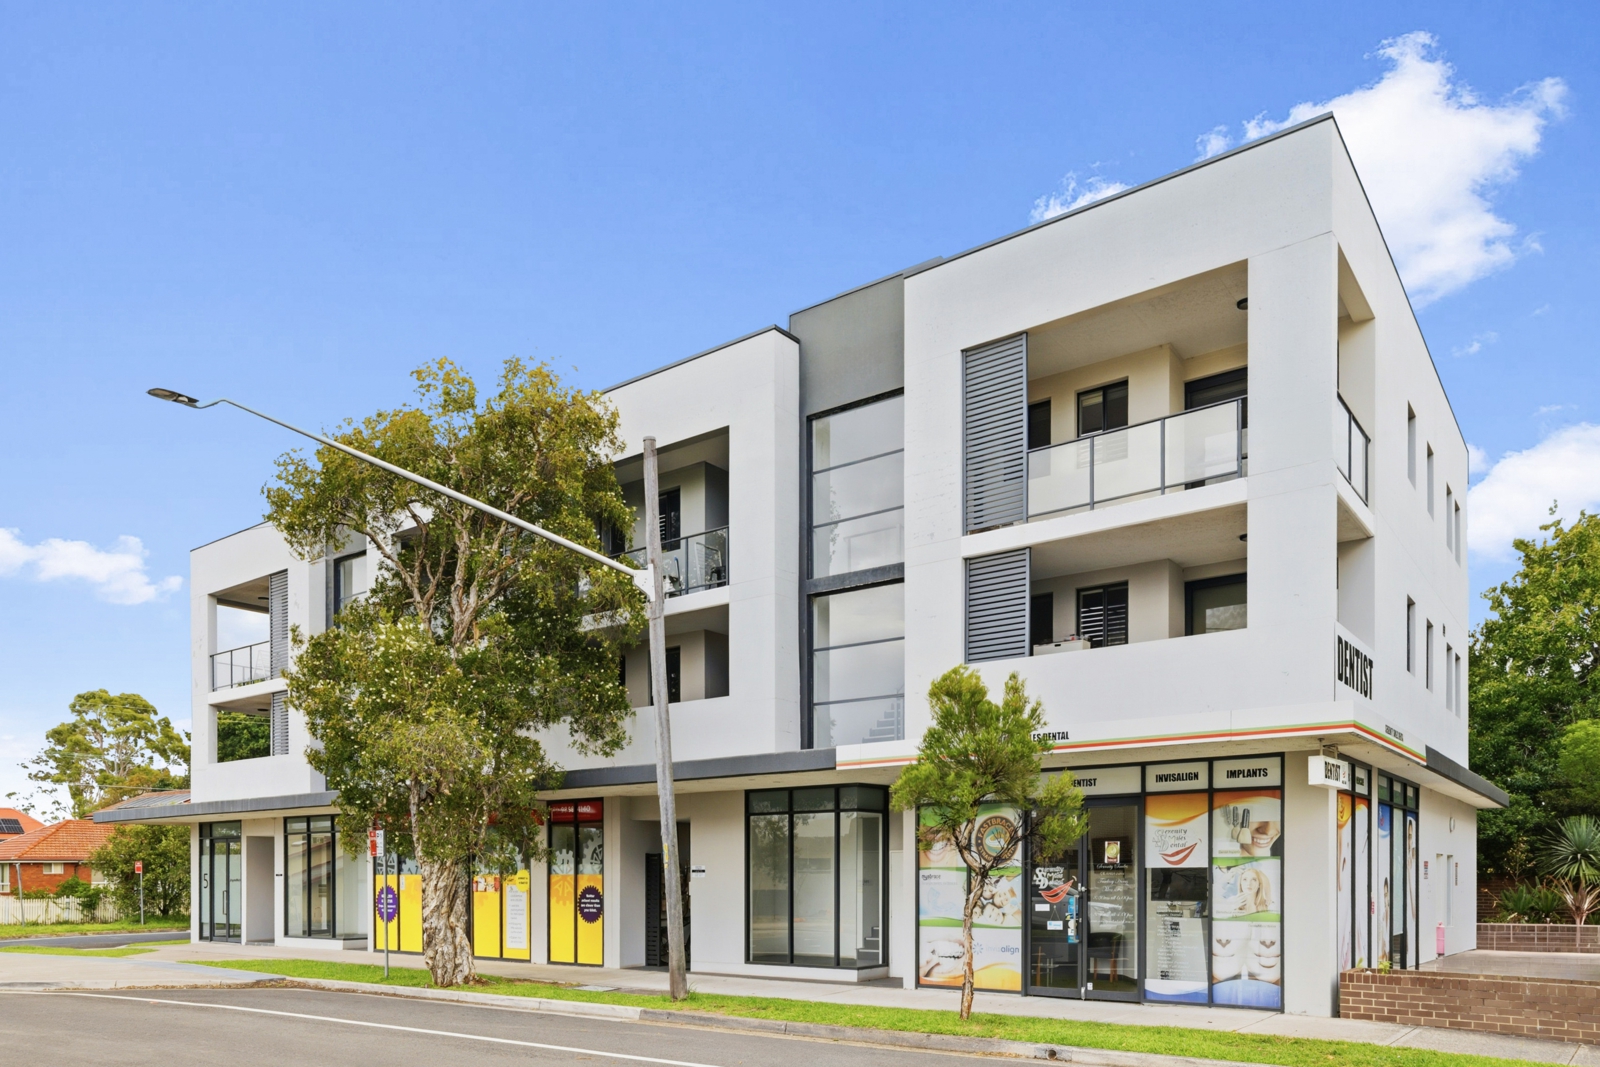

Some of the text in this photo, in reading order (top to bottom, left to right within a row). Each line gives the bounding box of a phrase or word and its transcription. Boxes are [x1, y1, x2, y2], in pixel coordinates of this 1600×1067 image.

[1337, 634, 1374, 701] DENTIST
[1042, 731, 1070, 741] DENTAL
[1155, 771, 1200, 783] INVISALIGN
[1226, 767, 1269, 779] IMPLANTS
[1324, 760, 1341, 783] DENTIST
[1071, 778, 1098, 788] ENTIST
[203, 873, 209, 889] 5
